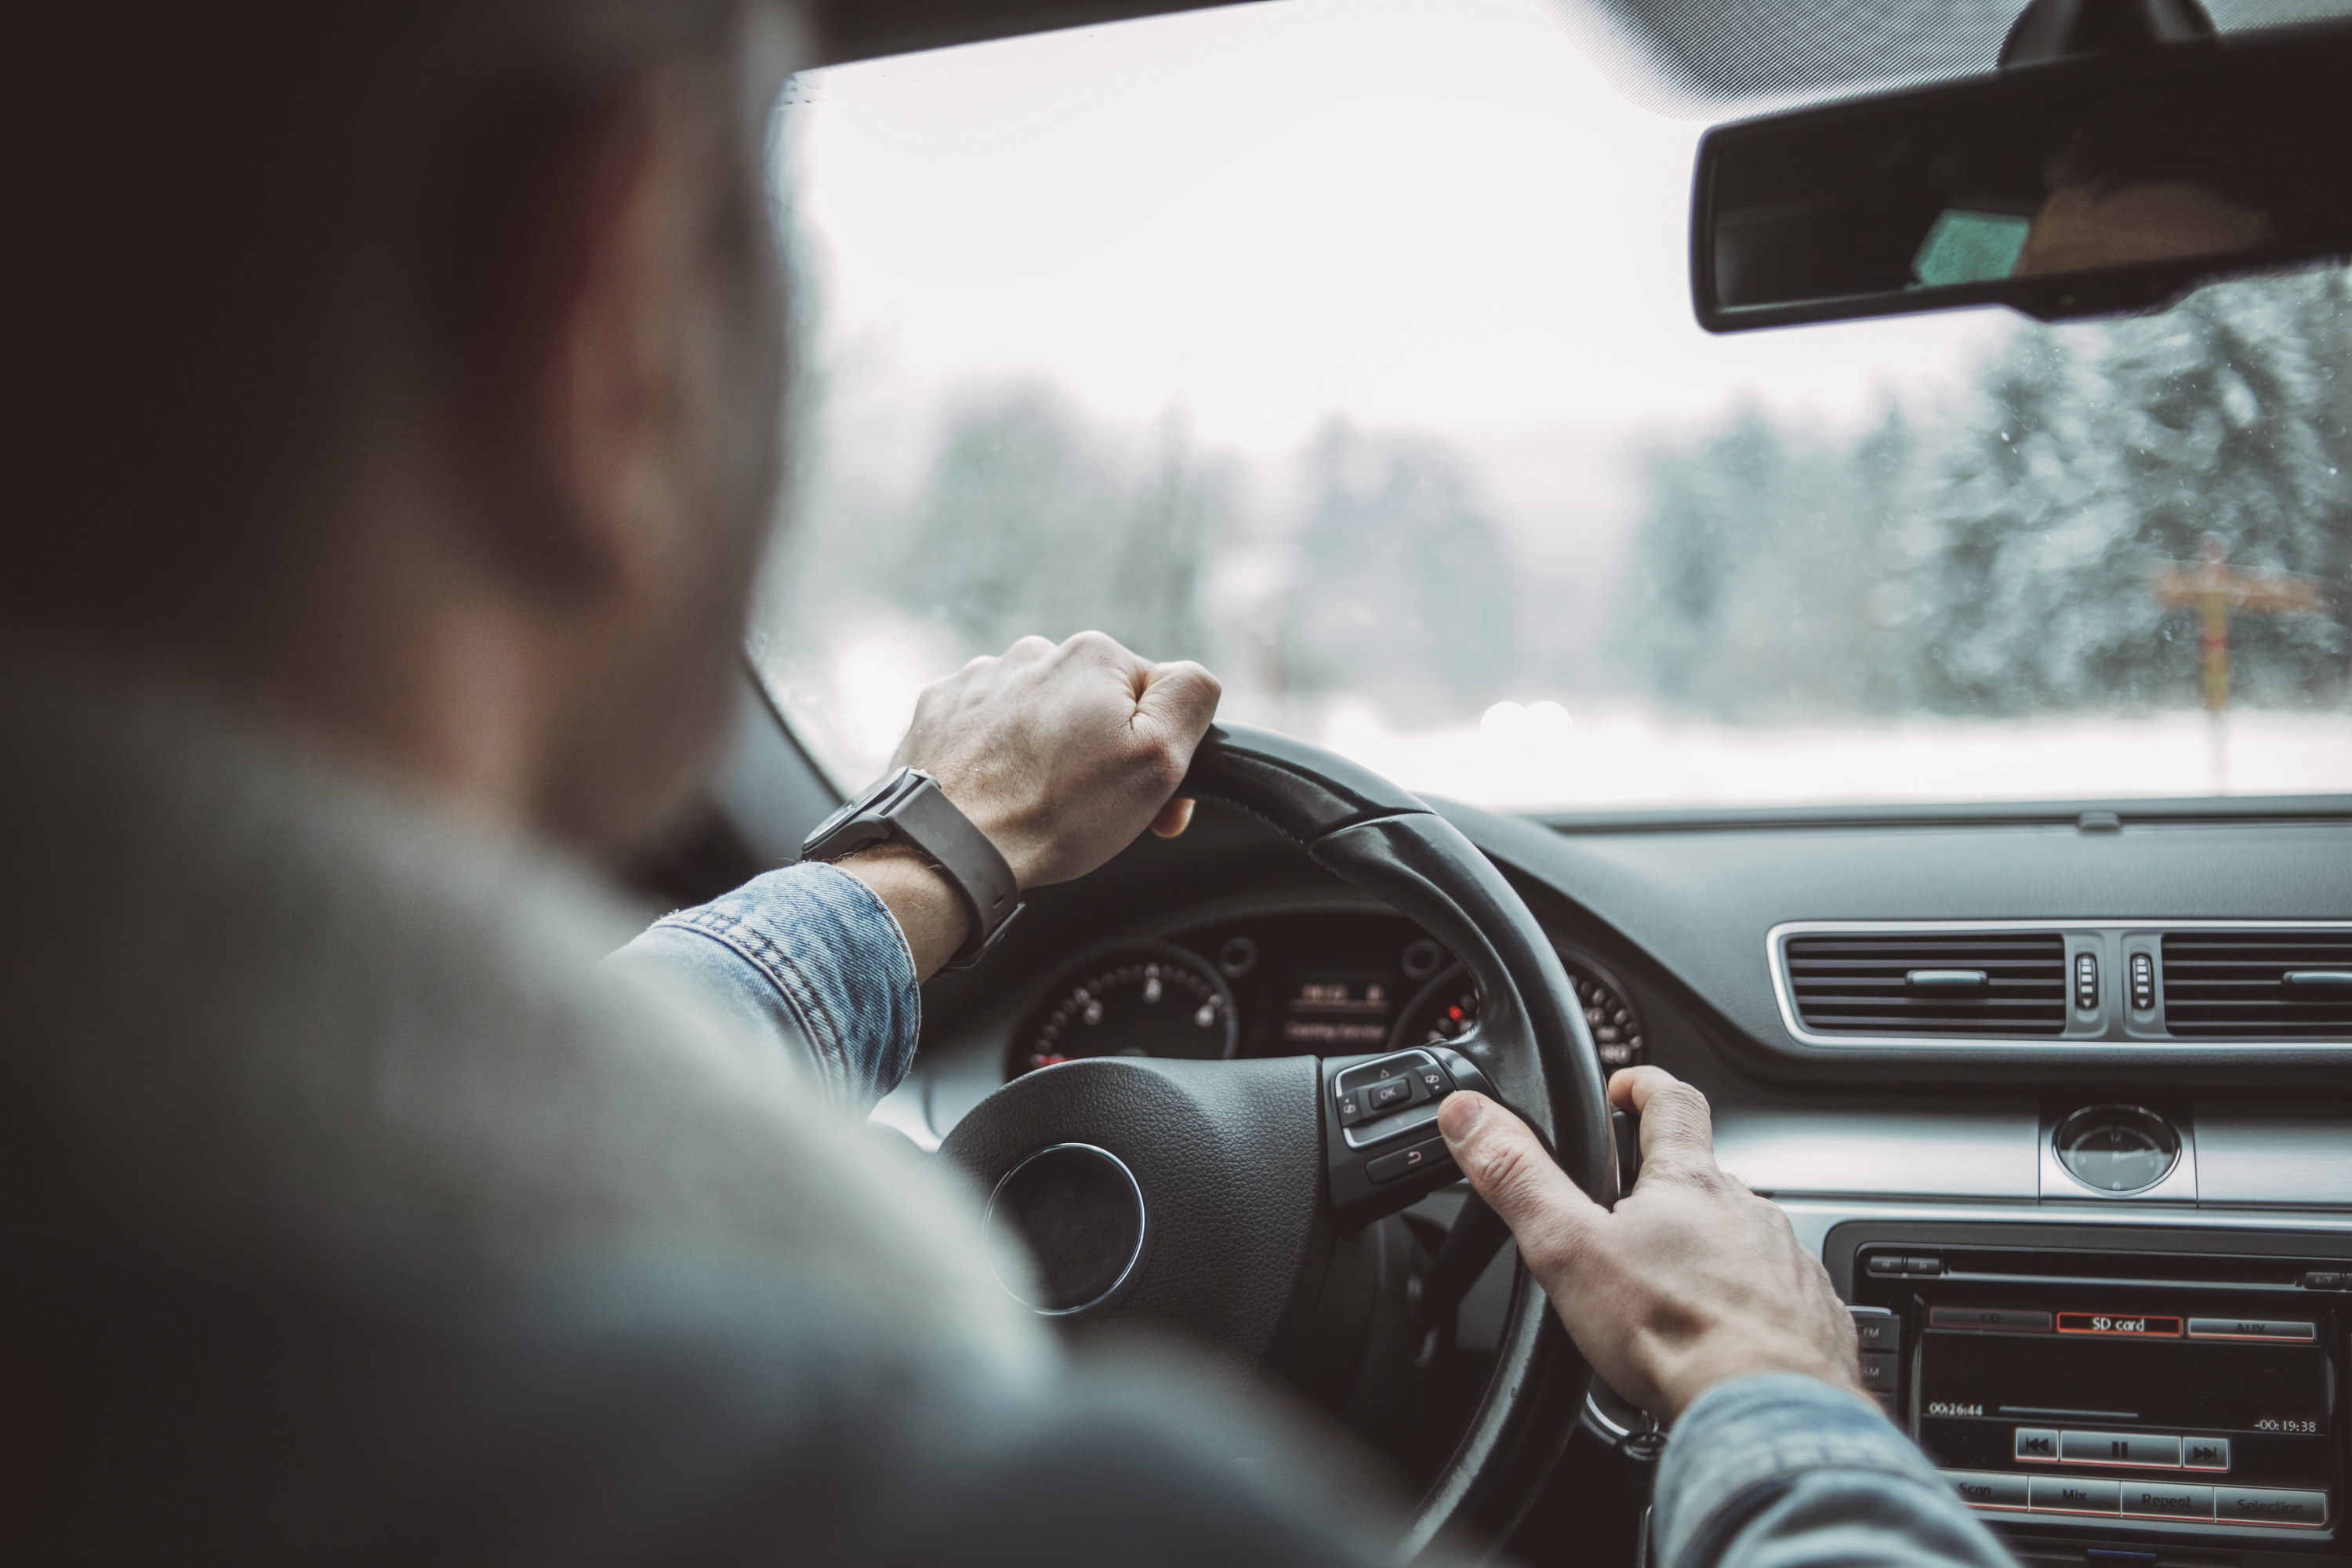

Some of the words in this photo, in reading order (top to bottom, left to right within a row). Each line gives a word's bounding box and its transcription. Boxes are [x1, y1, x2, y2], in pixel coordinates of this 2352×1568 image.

[1380, 1087, 1396, 1100] OK
[1980, 1312, 1999, 1324] CD
[2092, 1316, 2111, 1330] SD
[2115, 1318, 2145, 1332] card
[1863, 1327, 1879, 1338] FM
[2236, 1323, 2266, 1334] AUX
[1929, 1402, 1983, 1416] 00:26:44
[2254, 1420, 2316, 1432] -00:19:38
[1959, 1482, 1991, 1497] Scan
[2063, 1488, 2087, 1501] Mix
[2142, 1494, 2192, 1509] Repeat
[2238, 1498, 2303, 1514] Selection
